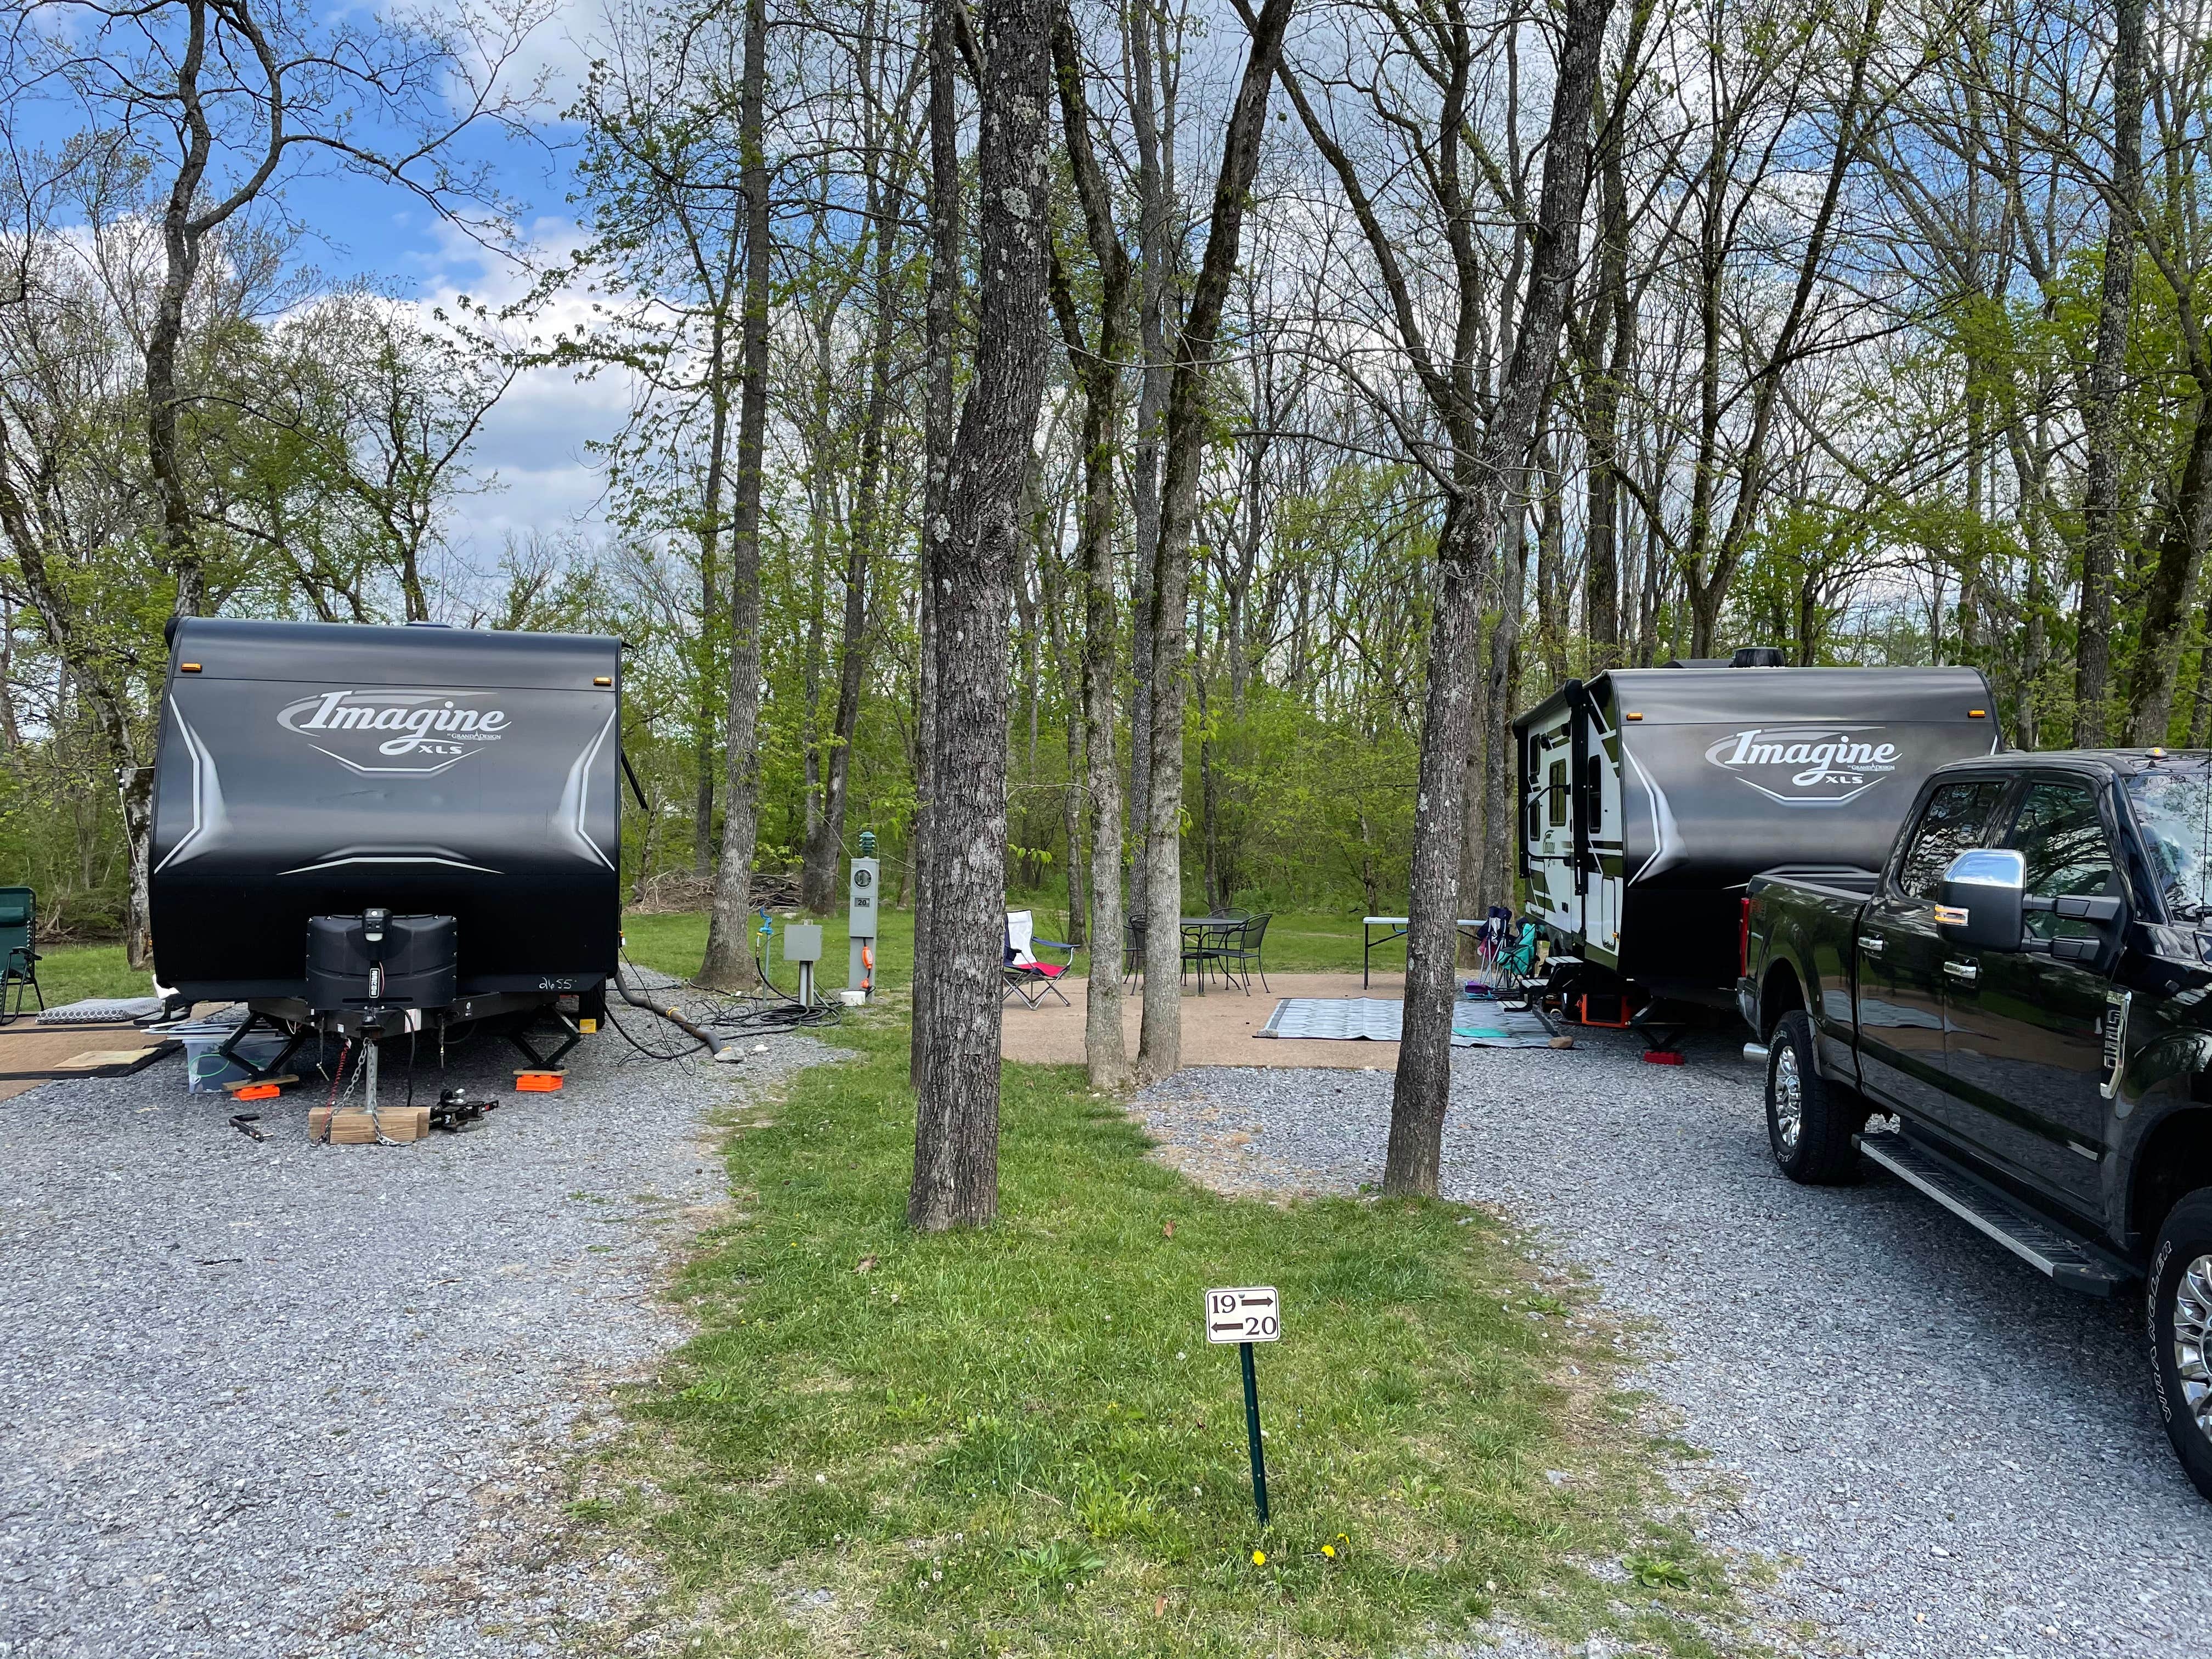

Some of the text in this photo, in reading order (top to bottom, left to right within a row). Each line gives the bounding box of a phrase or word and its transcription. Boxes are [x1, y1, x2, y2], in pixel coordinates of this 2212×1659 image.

[300, 690, 512, 755] Imagine
[418, 744, 462, 754] XLS
[1725, 729, 1903, 786] Imagine
[1825, 776, 1864, 784] XLS
[1212, 1295, 1236, 1314] 19
[1245, 1316, 1277, 1335] 20
[2146, 1240, 2172, 1424] WRANGLER
